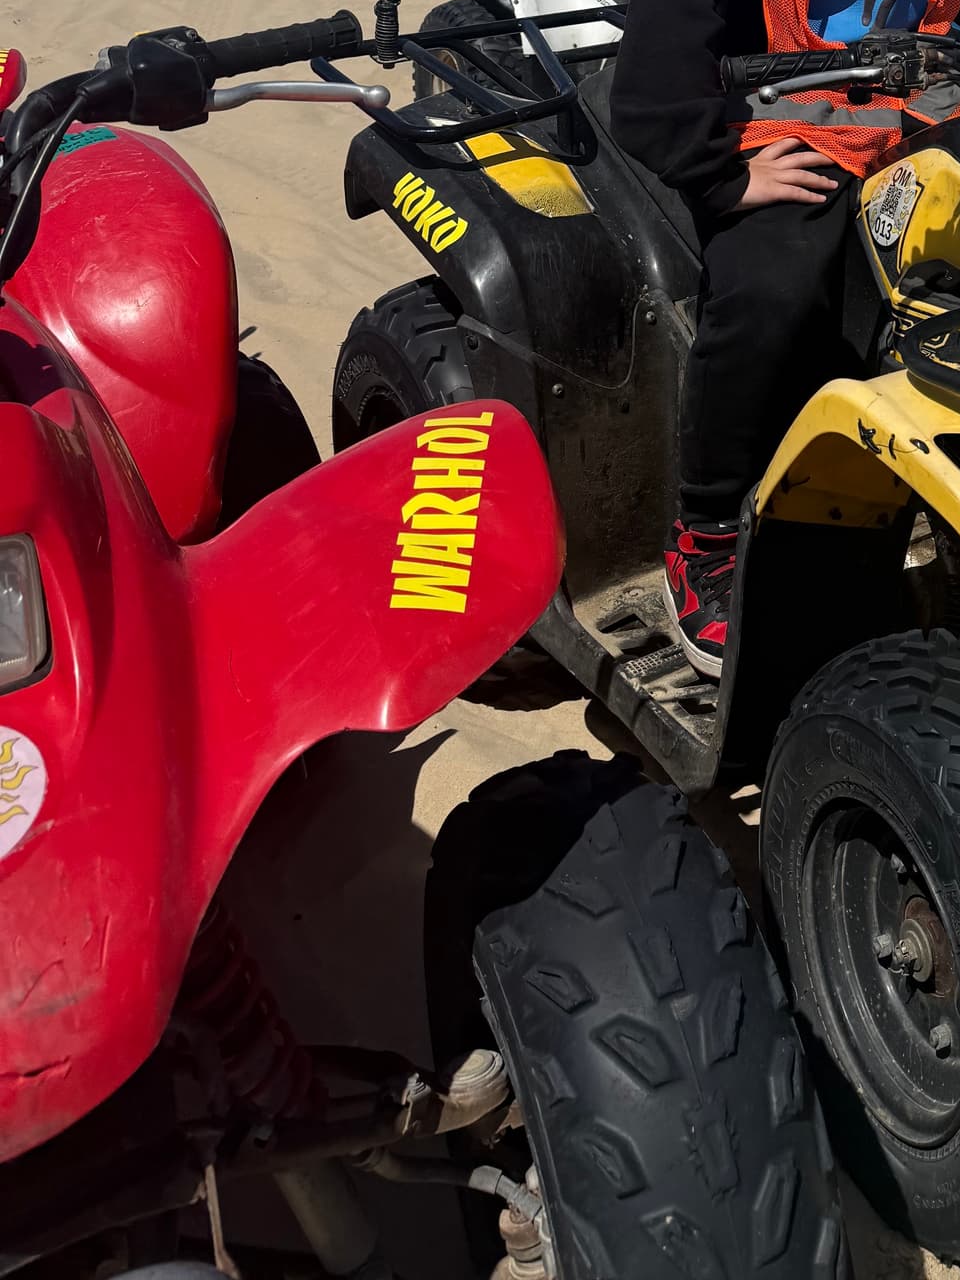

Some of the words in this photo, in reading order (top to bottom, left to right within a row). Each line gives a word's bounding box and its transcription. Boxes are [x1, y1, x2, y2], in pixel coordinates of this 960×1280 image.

[392, 171, 469, 254] YOKO
[874, 217, 893, 240] 013
[389, 411, 495, 614] WARHOL
